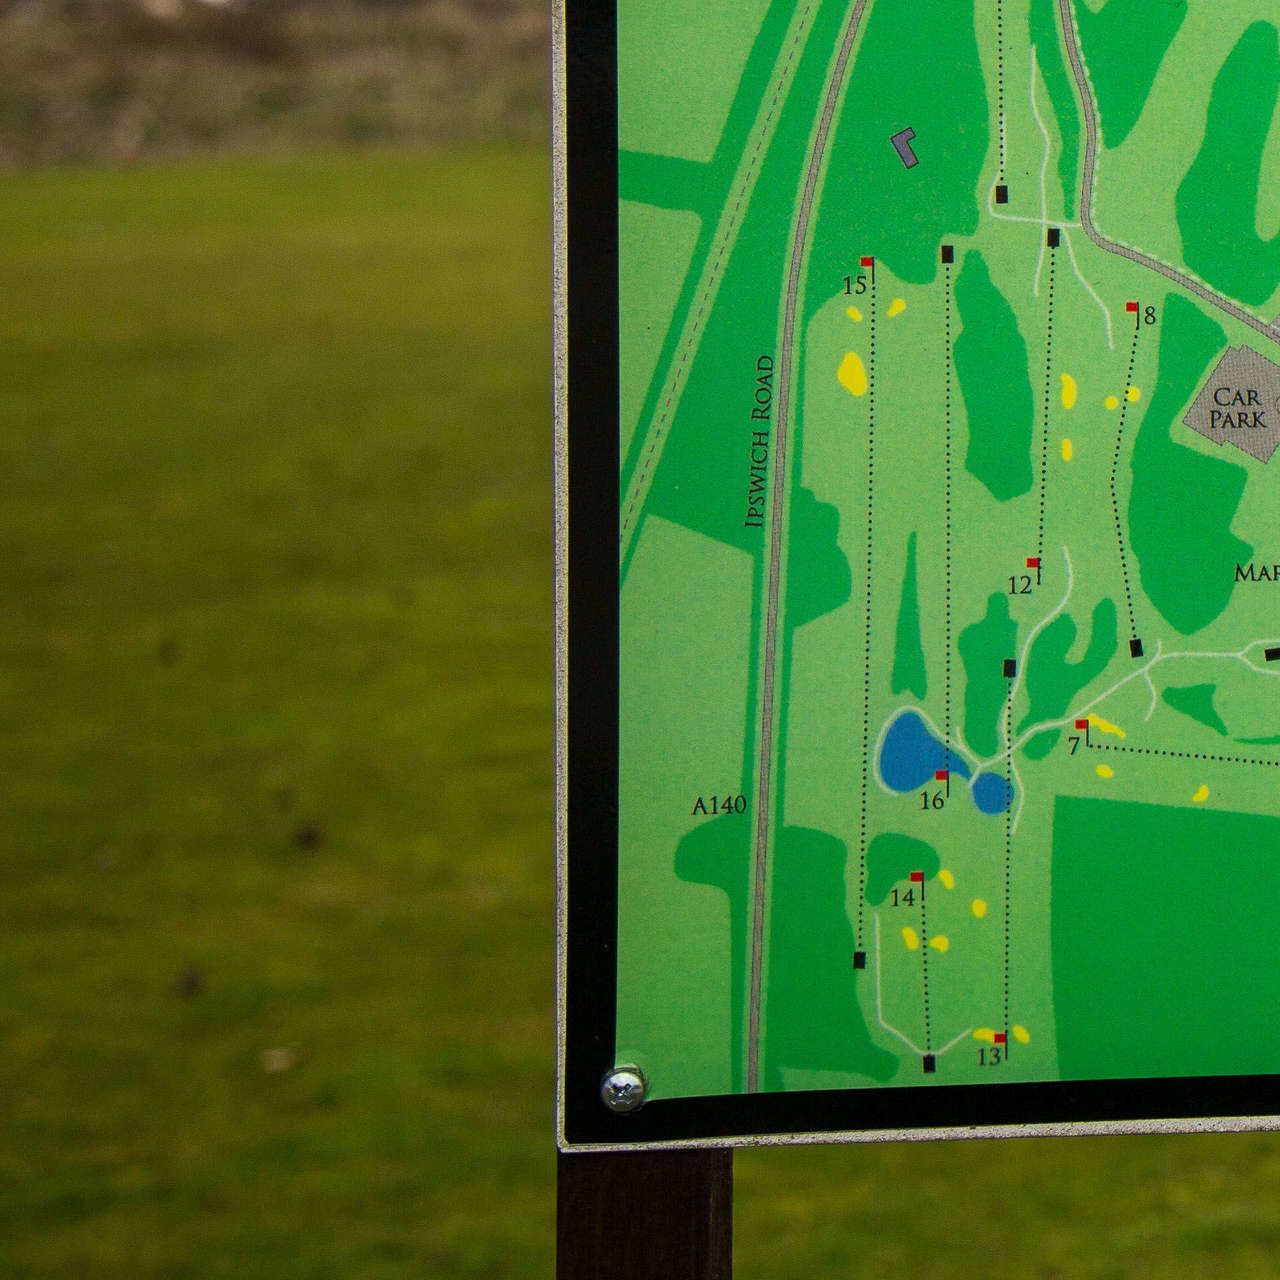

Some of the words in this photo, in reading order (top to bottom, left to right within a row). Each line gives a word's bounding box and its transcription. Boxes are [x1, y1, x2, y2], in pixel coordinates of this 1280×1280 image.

[844, 276, 866, 294] 15
[1144, 306, 1156, 325] 8
[752, 356, 773, 420] ROAD
[1214, 387, 1262, 406] CAR
[1210, 410, 1267, 429] PARK
[745, 431, 769, 528] IPSWICH
[1009, 576, 1031, 594] 12
[1069, 737, 1079, 755] 7
[692, 795, 746, 815] A140
[921, 791, 944, 809] 16
[892, 888, 915, 906] 14
[979, 1048, 1000, 1066] 13
